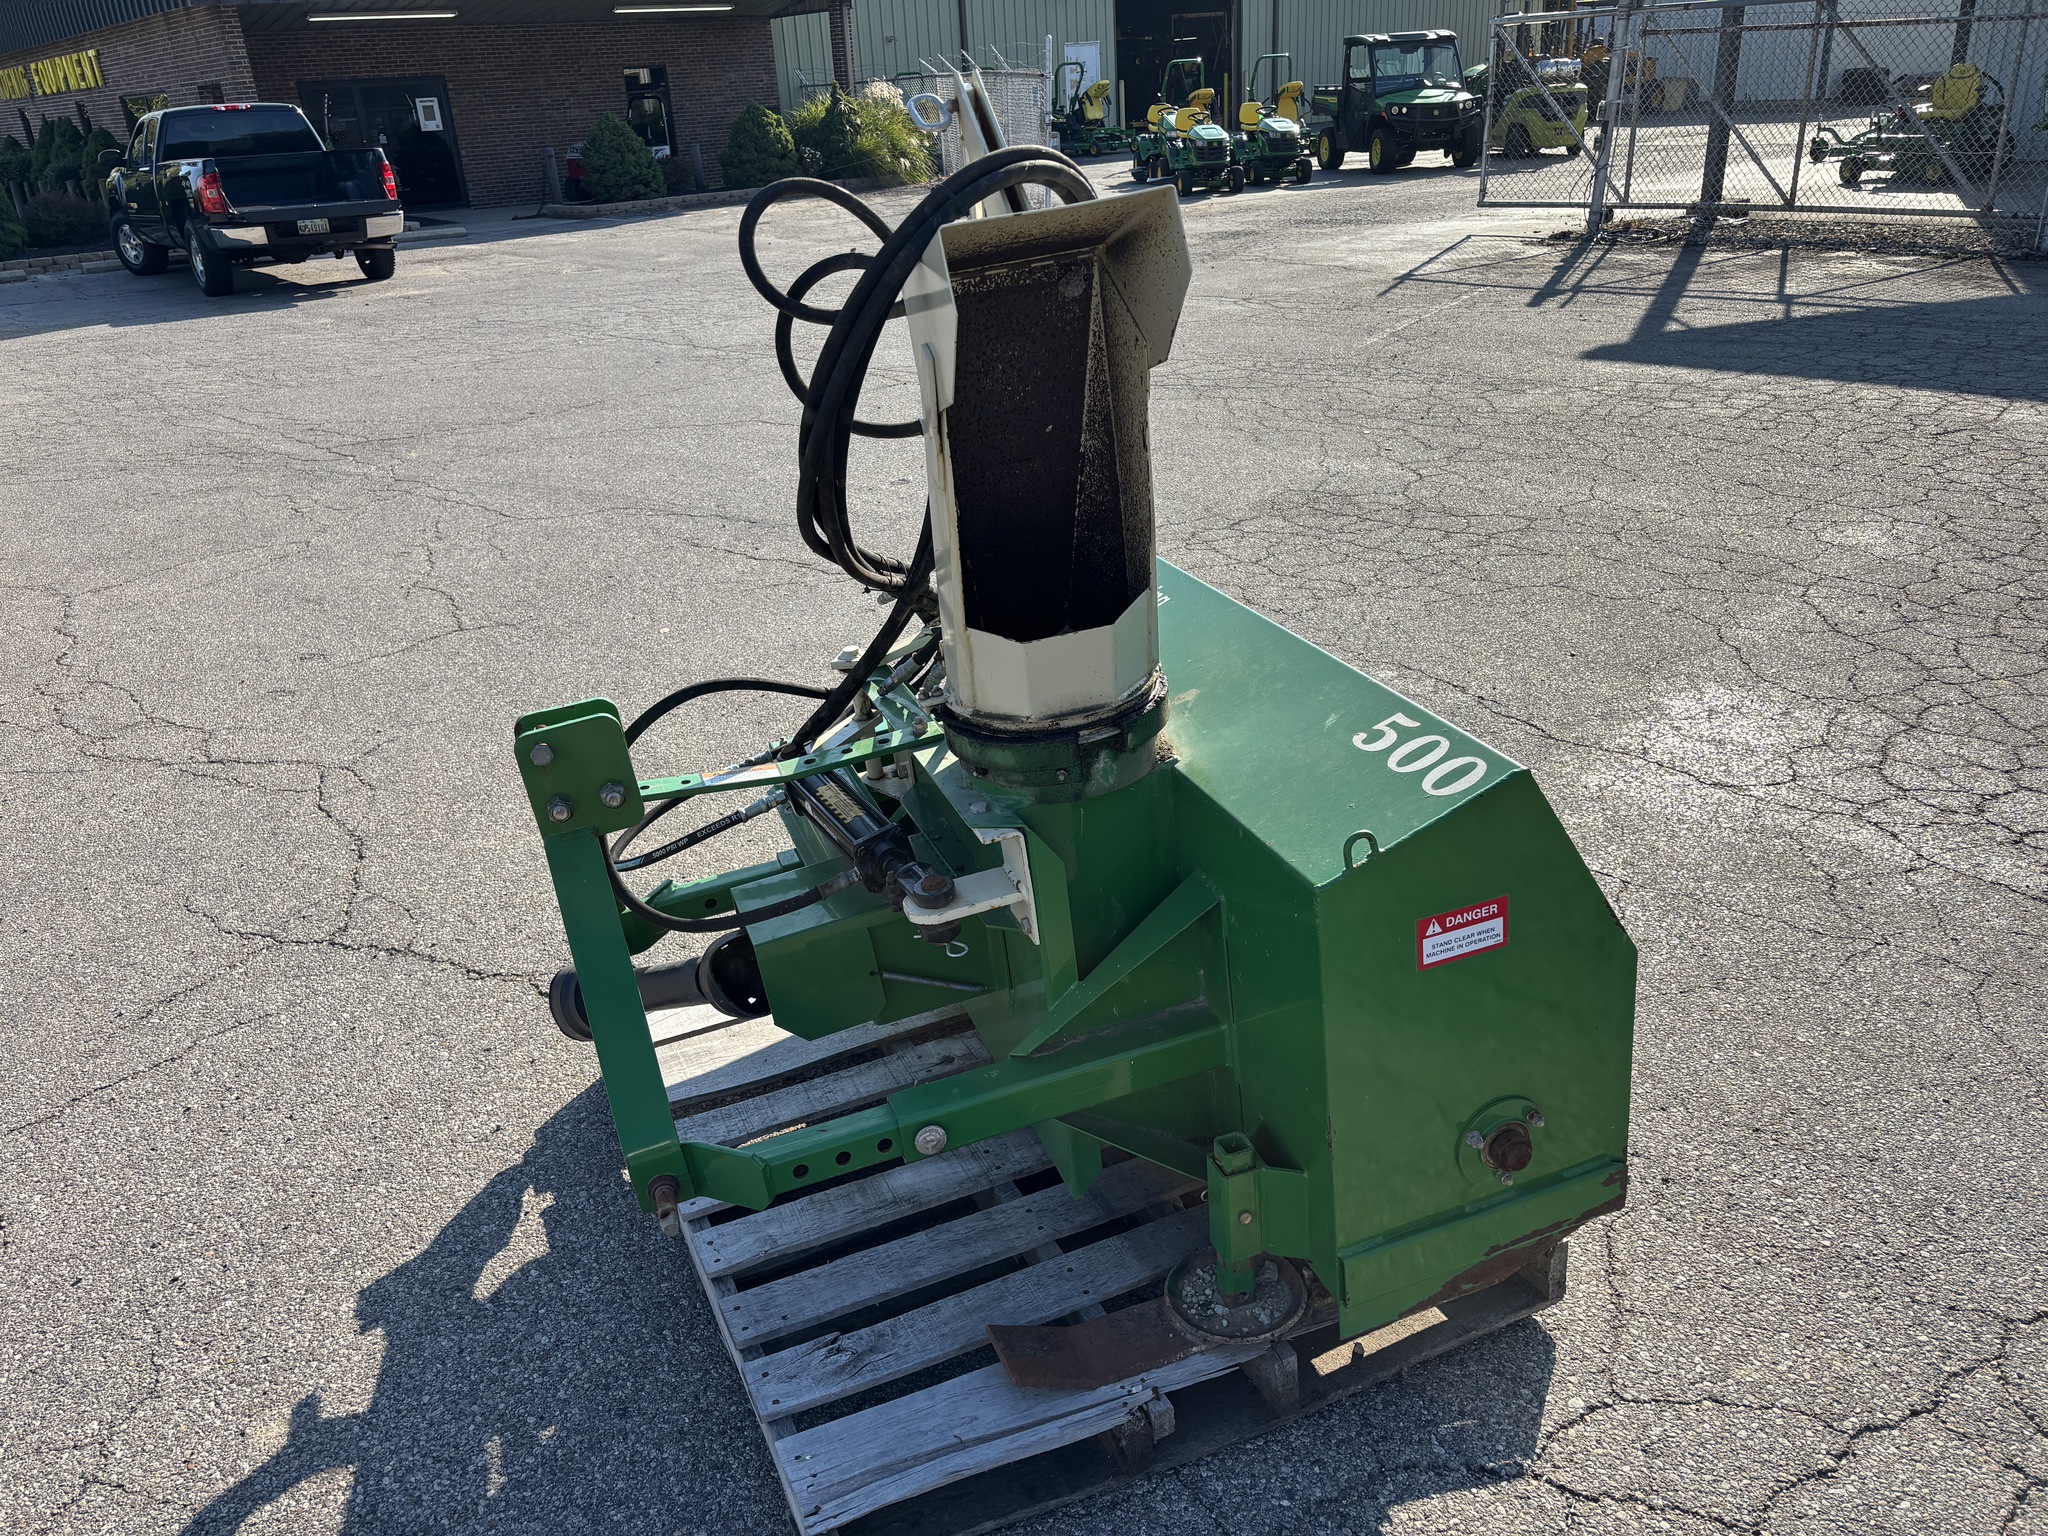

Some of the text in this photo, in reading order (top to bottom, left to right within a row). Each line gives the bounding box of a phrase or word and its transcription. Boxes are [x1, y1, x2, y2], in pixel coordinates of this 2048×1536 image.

[1352, 712, 1487, 796] 500
[652, 848, 667, 859] 5000
[666, 843, 677, 853] PSI
[677, 837, 689, 847] WP
[697, 817, 731, 838] EXCEEDS
[1446, 904, 1498, 928] DANGER
[1425, 945, 1456, 959] MACHINE
[1464, 932, 1501, 948] OPERATION
[1431, 926, 1496, 950] STAND CLEAR WHEN
